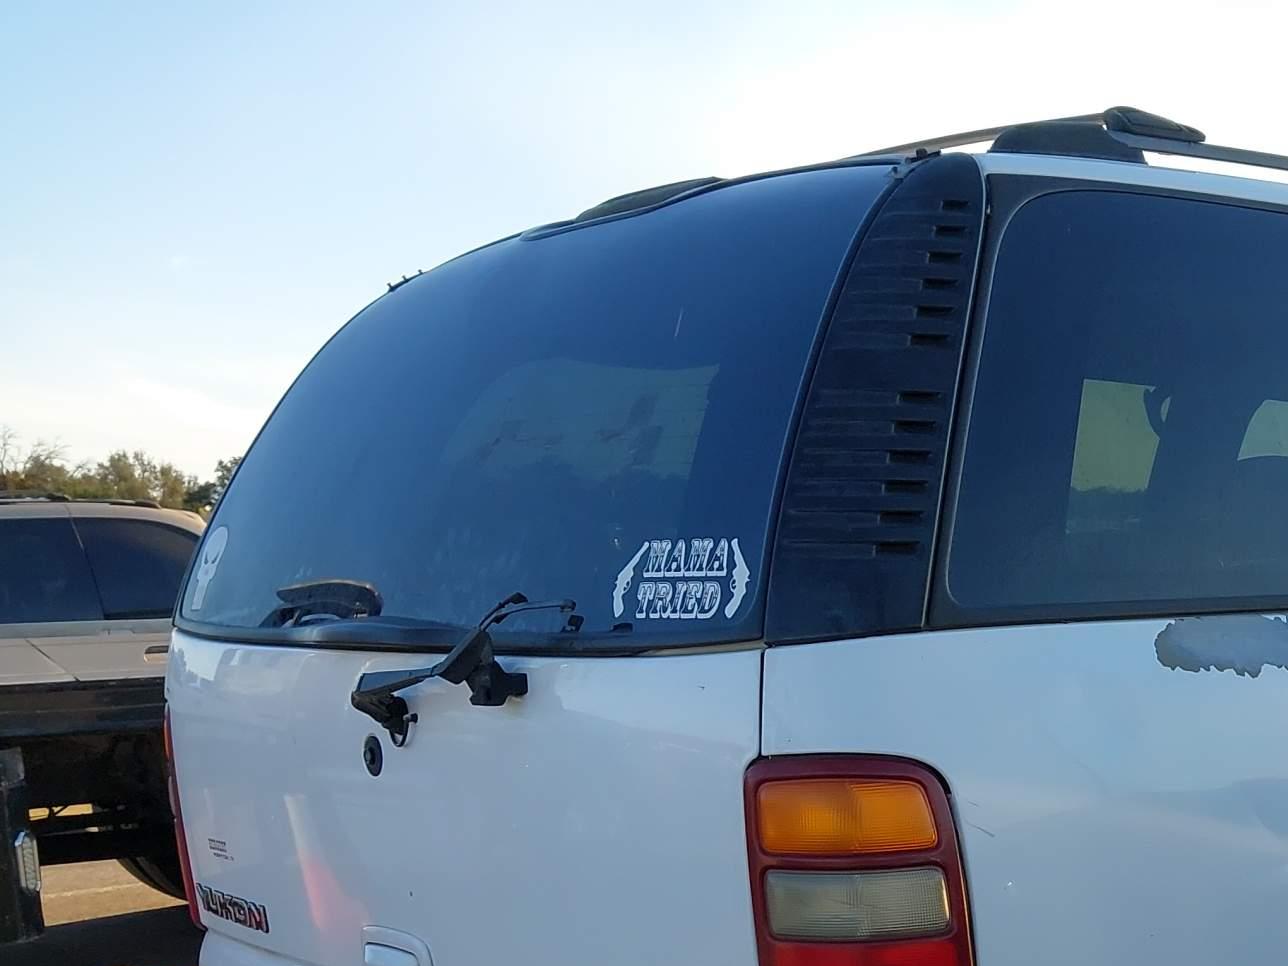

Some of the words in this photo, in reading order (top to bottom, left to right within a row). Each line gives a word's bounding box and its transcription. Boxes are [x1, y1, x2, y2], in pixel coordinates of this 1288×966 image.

[642, 538, 729, 578] MAMA
[635, 580, 722, 620] TRIED
[195, 882, 270, 934] YUKON
